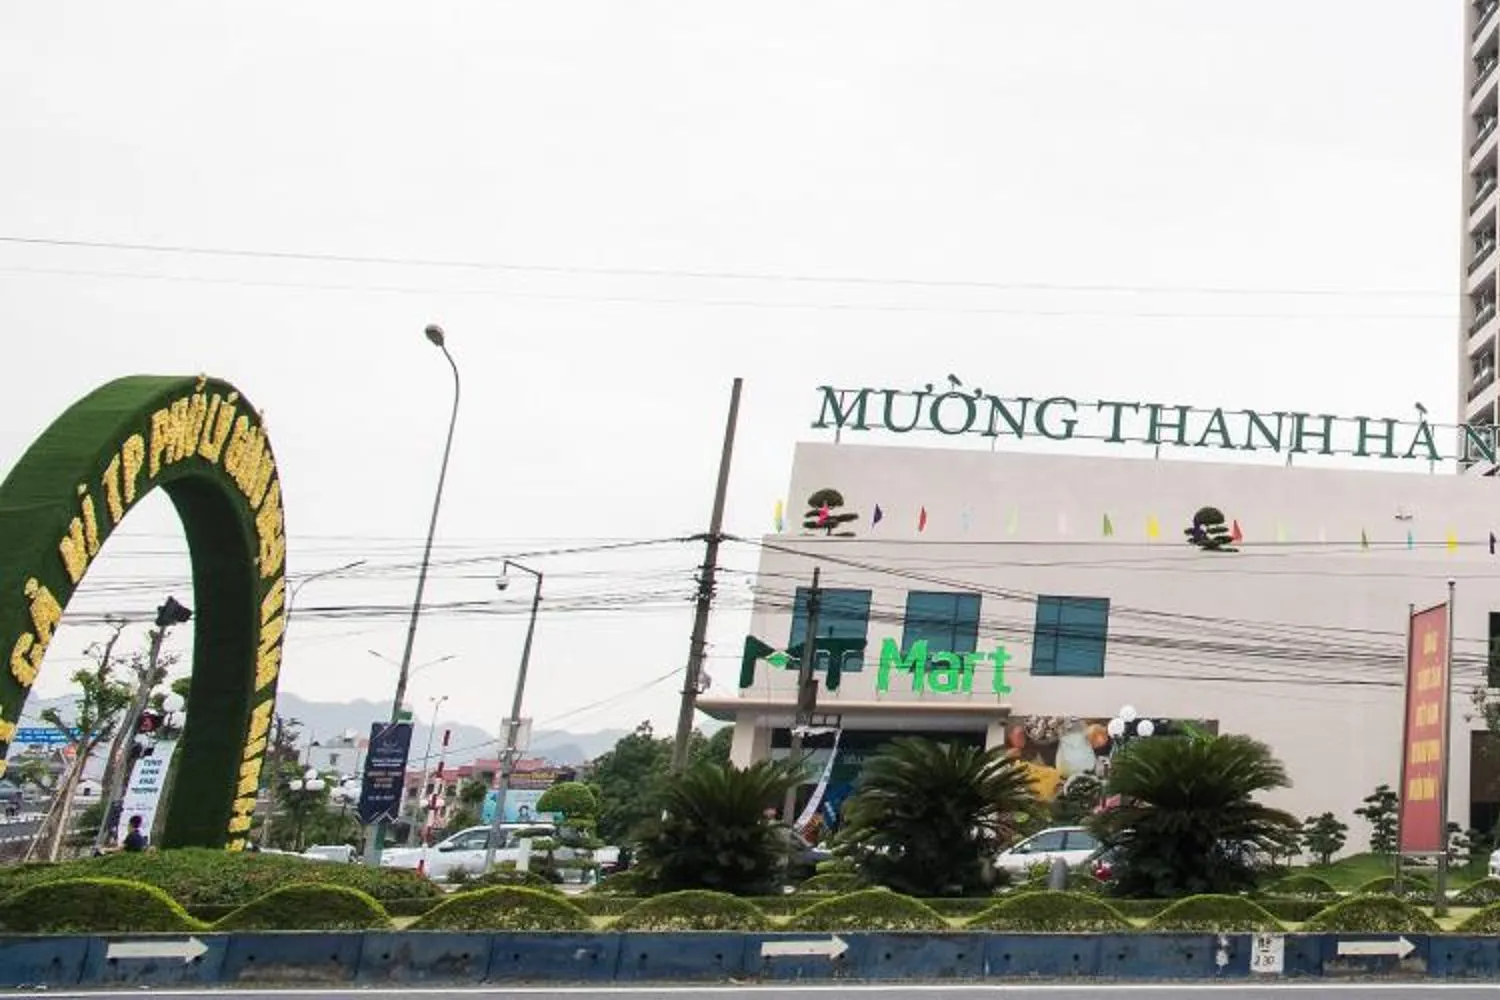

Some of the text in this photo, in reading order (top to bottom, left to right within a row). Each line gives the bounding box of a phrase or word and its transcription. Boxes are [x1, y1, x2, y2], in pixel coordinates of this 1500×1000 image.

[811, 374, 1079, 440] MƯỜNG
[1097, 399, 1337, 455] THANH
[1351, 402, 1443, 460] HÀ
[102, 433, 145, 523] TP
[877, 636, 1012, 694] Mart
